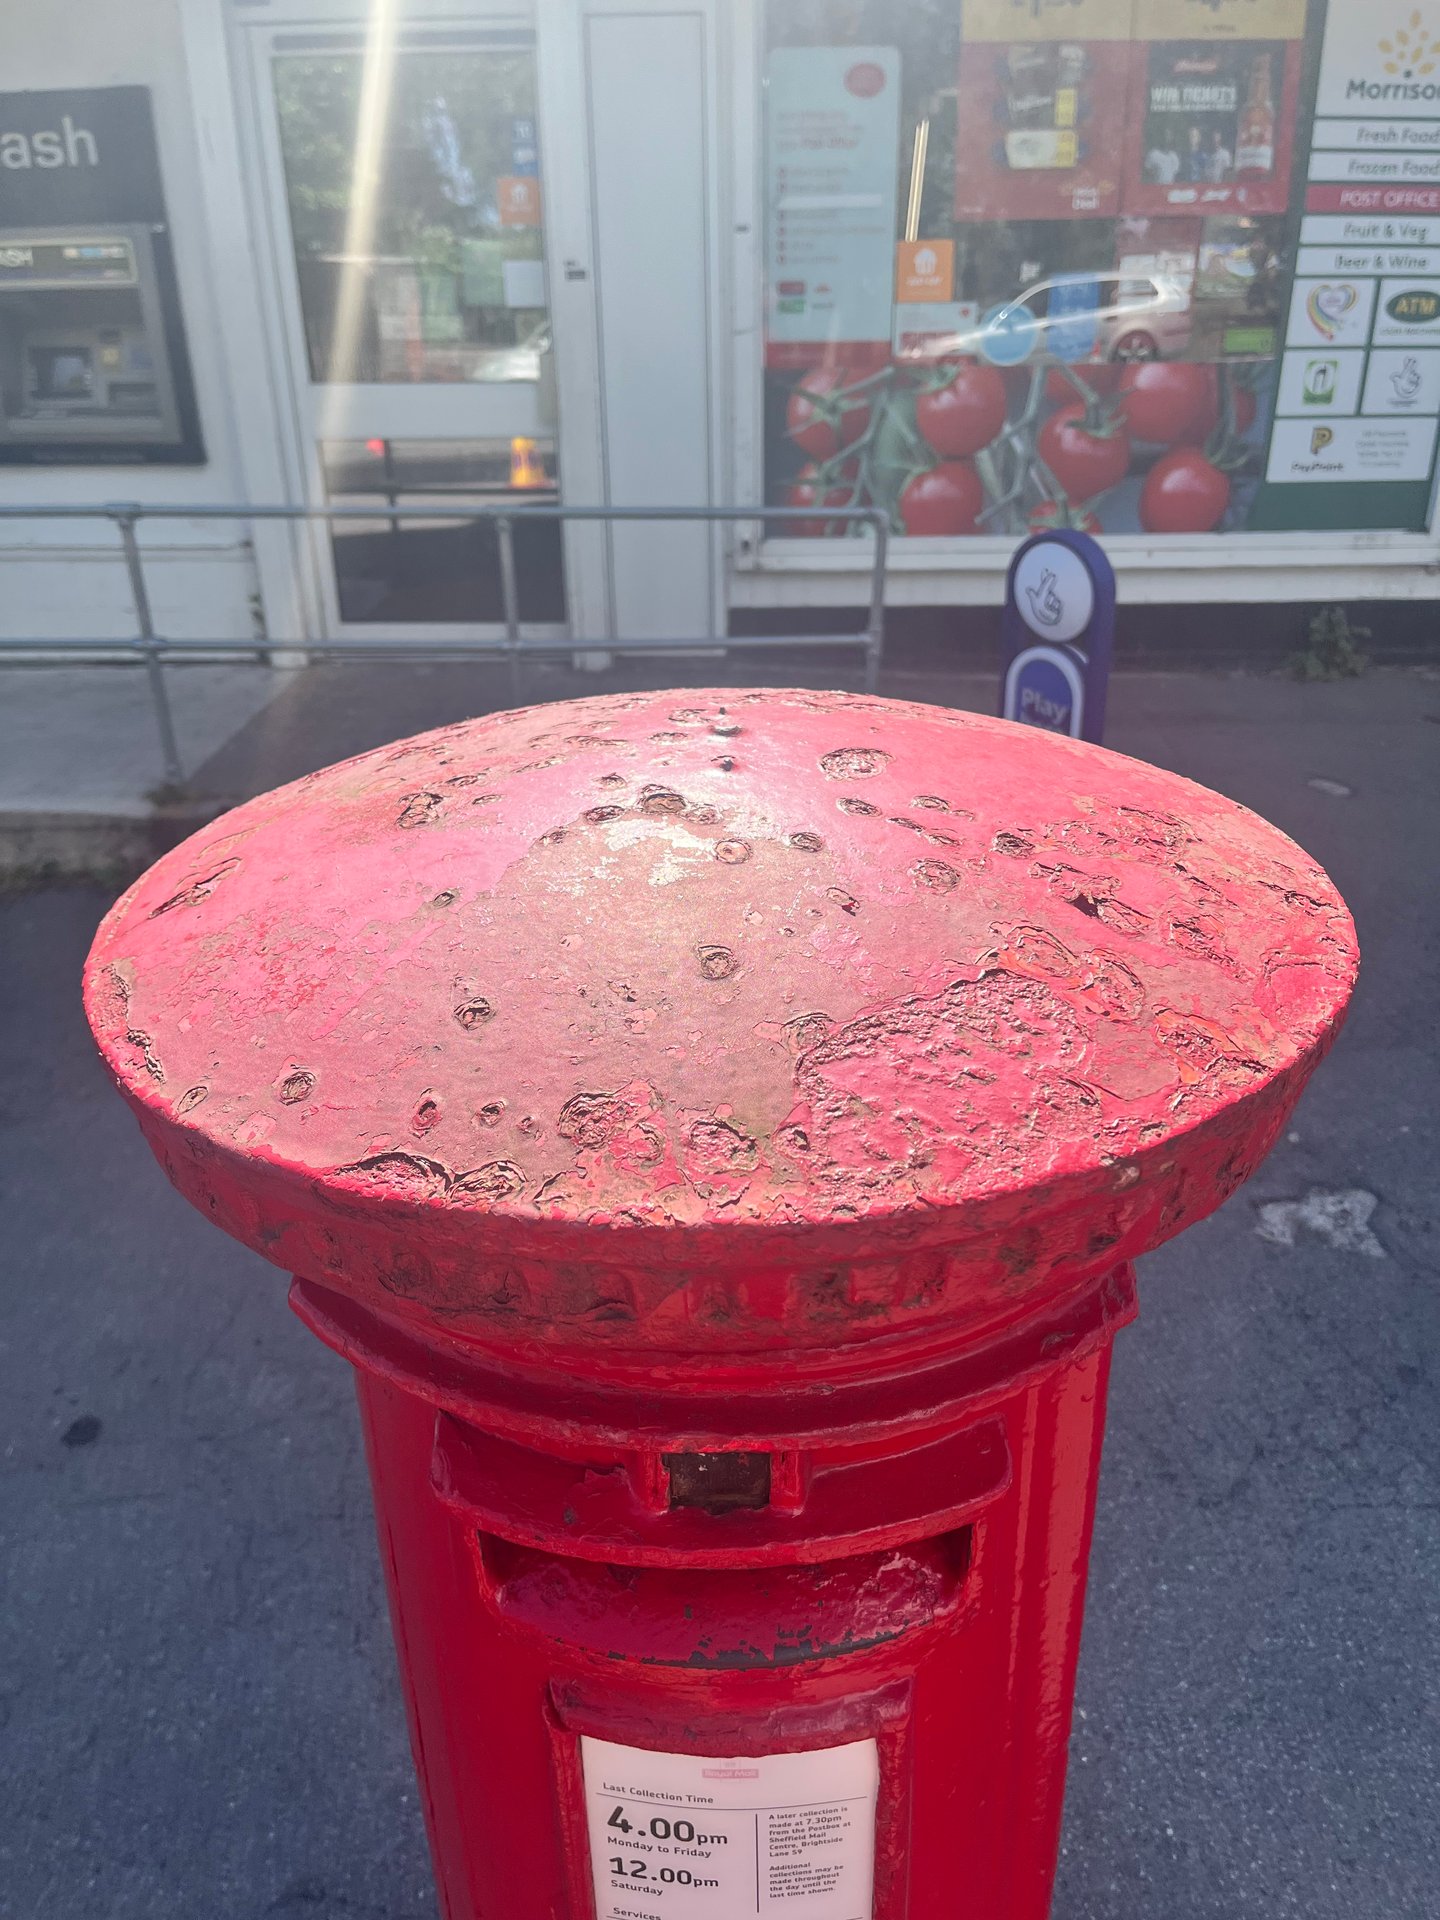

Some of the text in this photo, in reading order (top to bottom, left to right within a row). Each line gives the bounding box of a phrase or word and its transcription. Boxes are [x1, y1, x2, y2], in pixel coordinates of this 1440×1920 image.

[1356, 127, 1398, 143] Fresh
[1347, 159, 1398, 175] Frozen
[1340, 191, 1439, 208] POST OFFICE
[1343, 222, 1380, 238] Fruit
[1400, 222, 1429, 244] Veg
[1334, 254, 1367, 270] Beer
[1388, 254, 1428, 270] Wine
[1394, 298, 1436, 314] ATM
[1021, 688, 1067, 725] Play
[603, 1782, 714, 1804] Last Collection Time
[799, 1808, 839, 1817] collection
[806, 1815, 842, 1825] 7.30pm
[607, 1805, 728, 1846] 4.00pm
[808, 1823, 840, 1832] Postbox
[769, 1834, 806, 1843] Sheffield
[801, 1837, 843, 1847] Brightside
[607, 1836, 653, 1852] Monday
[674, 1847, 712, 1858] Friday
[609, 1857, 719, 1887] 12.00pm
[769, 1862, 811, 1871] Additional
[769, 1870, 812, 1878] collections
[815, 1866, 832, 1874] may
[794, 1872, 840, 1882] throughout
[611, 1880, 663, 1896] Saturday
[785, 1883, 800, 1891] day
[802, 1881, 821, 1889] until
[808, 1886, 836, 1895] shown.
[613, 1907, 661, 1920] Services
